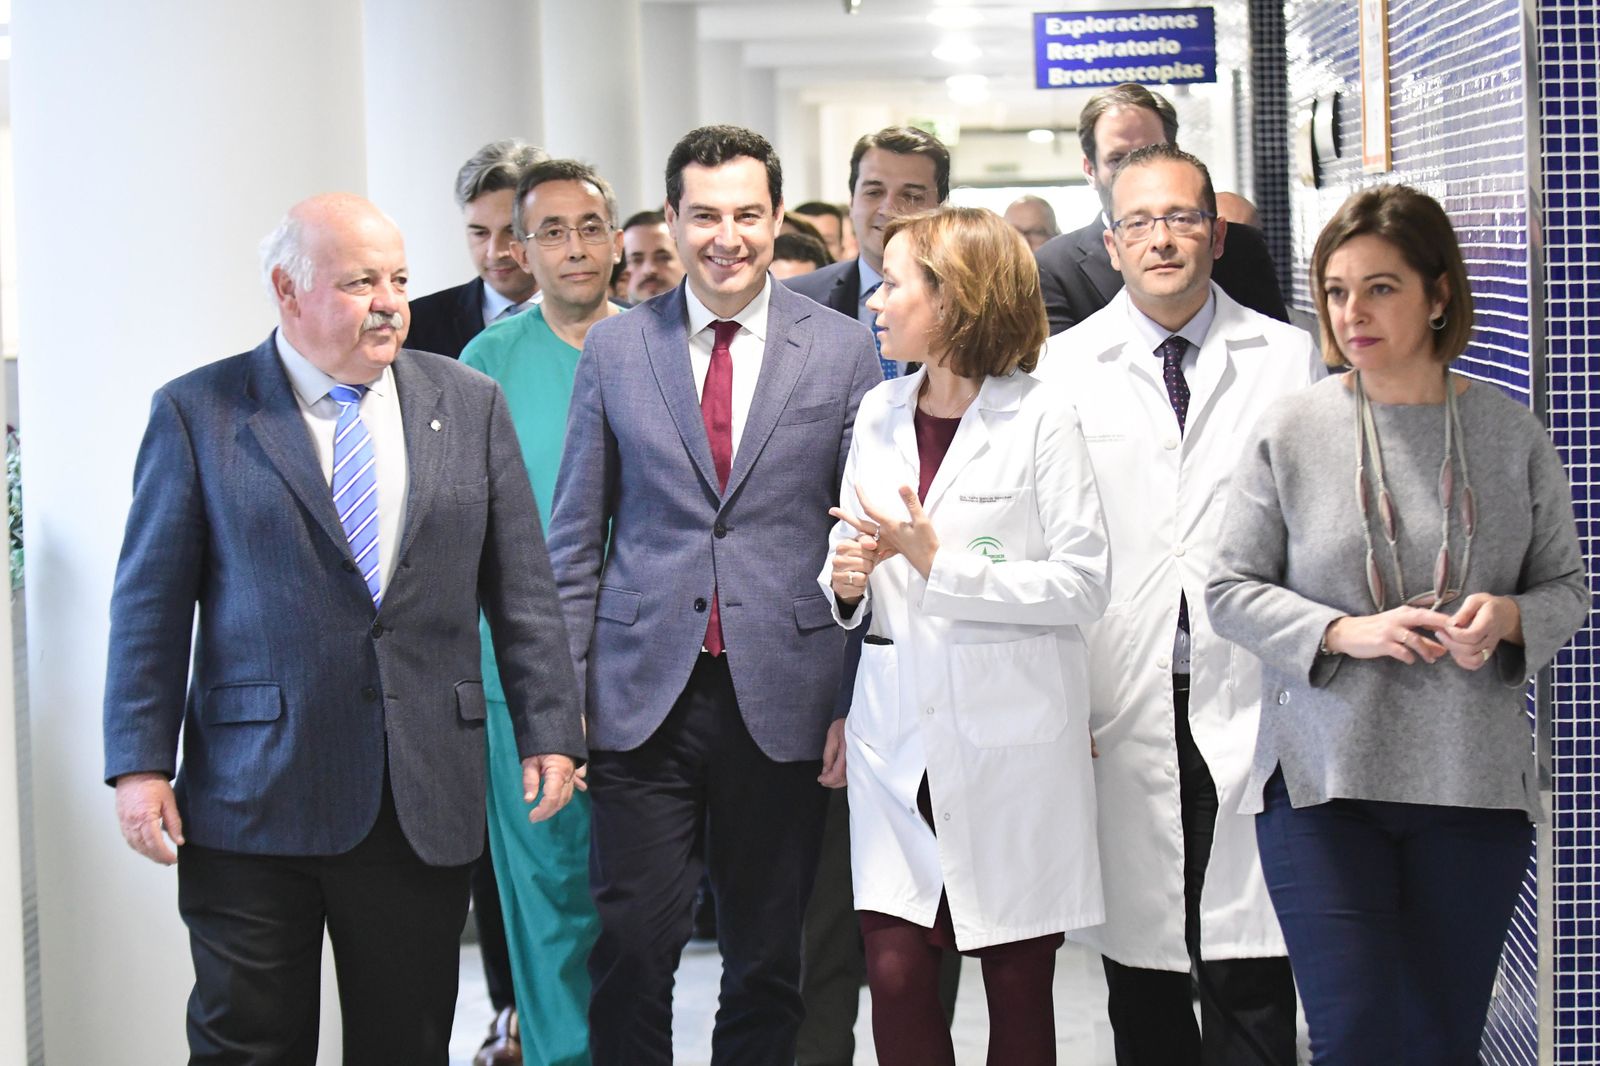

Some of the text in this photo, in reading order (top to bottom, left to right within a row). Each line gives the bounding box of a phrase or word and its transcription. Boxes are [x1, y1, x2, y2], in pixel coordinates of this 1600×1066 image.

[1045, 14, 1199, 39] Exploraciones
[1046, 37, 1181, 63] Respiratorio
[1048, 62, 1205, 86] Broncoscopias
